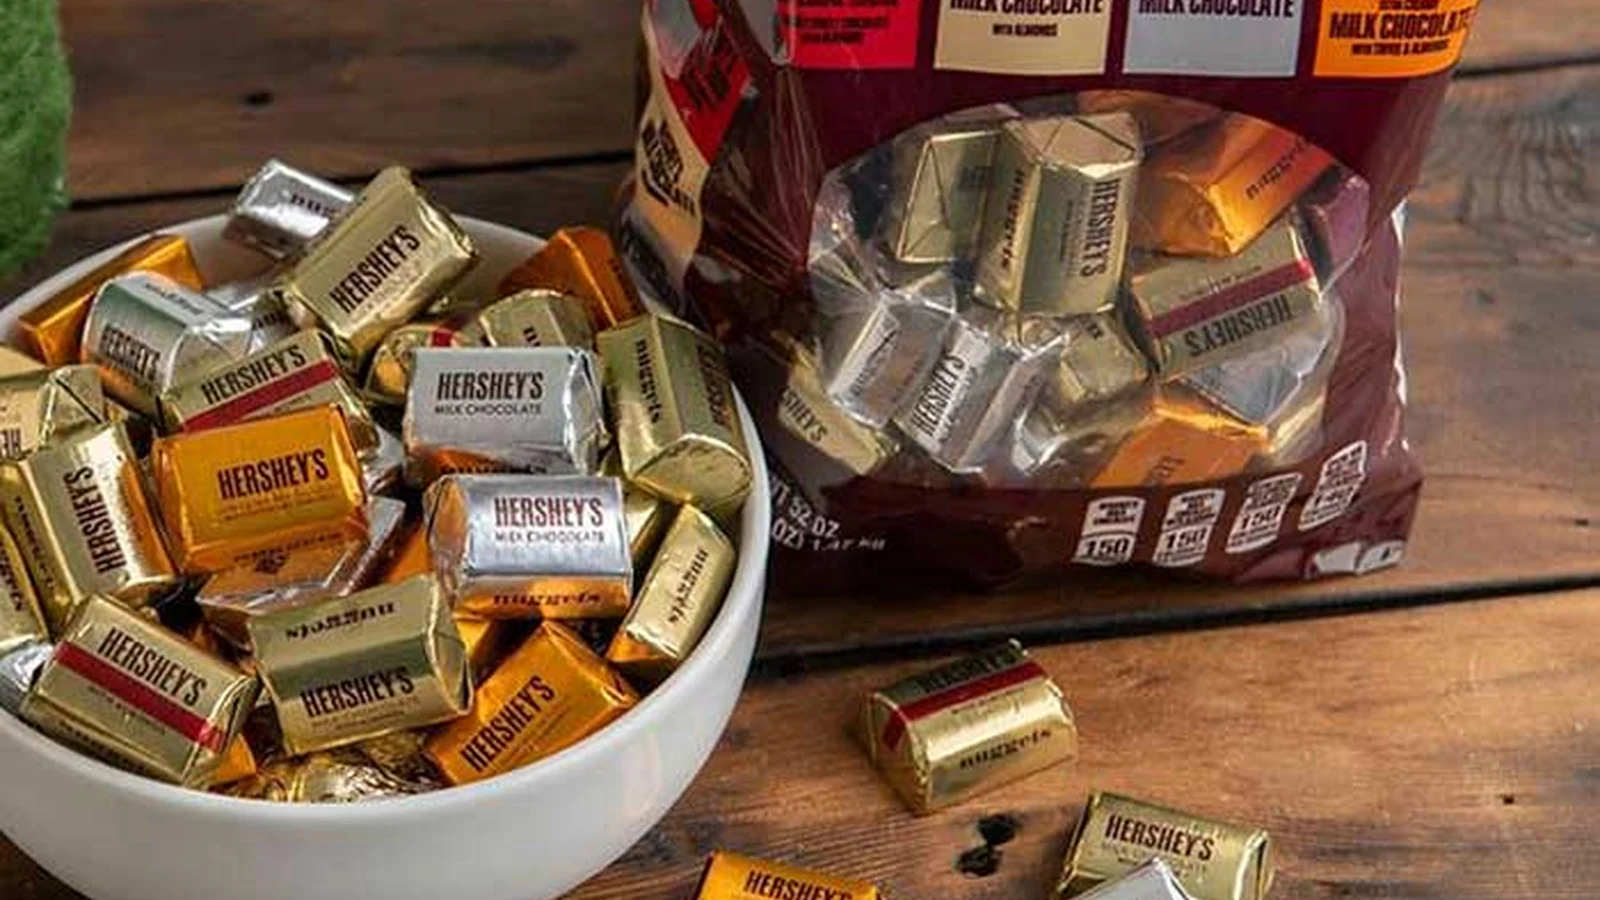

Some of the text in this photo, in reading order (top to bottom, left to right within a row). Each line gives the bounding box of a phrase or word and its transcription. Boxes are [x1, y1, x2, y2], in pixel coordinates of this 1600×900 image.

[1330, 7, 1472, 39] MILK CHOCOLAT
[1081, 178, 1121, 277] HERSHEY'S
[329, 224, 421, 314] HERSHEY'S
[1183, 294, 1293, 358] HERSHEY'S
[201, 344, 306, 405] HERSHEY'S
[437, 371, 545, 401] HERSHEY'S
[435, 403, 542, 416] MILK CHOCOLATE
[217, 448, 330, 500] HERSHEY'S
[63, 466, 127, 575] HERSHEY'S
[494, 497, 604, 527] HERSHEY'S
[1084, 537, 1130, 555] 150
[1165, 526, 1207, 551] 150
[99, 627, 207, 707] HERSHEY'S
[301, 665, 415, 718] HERSHEY'S
[460, 674, 555, 773] HERSHEY'S
[1104, 813, 1216, 862] HERSHEY'S
[743, 870, 854, 900] HERSHE'
